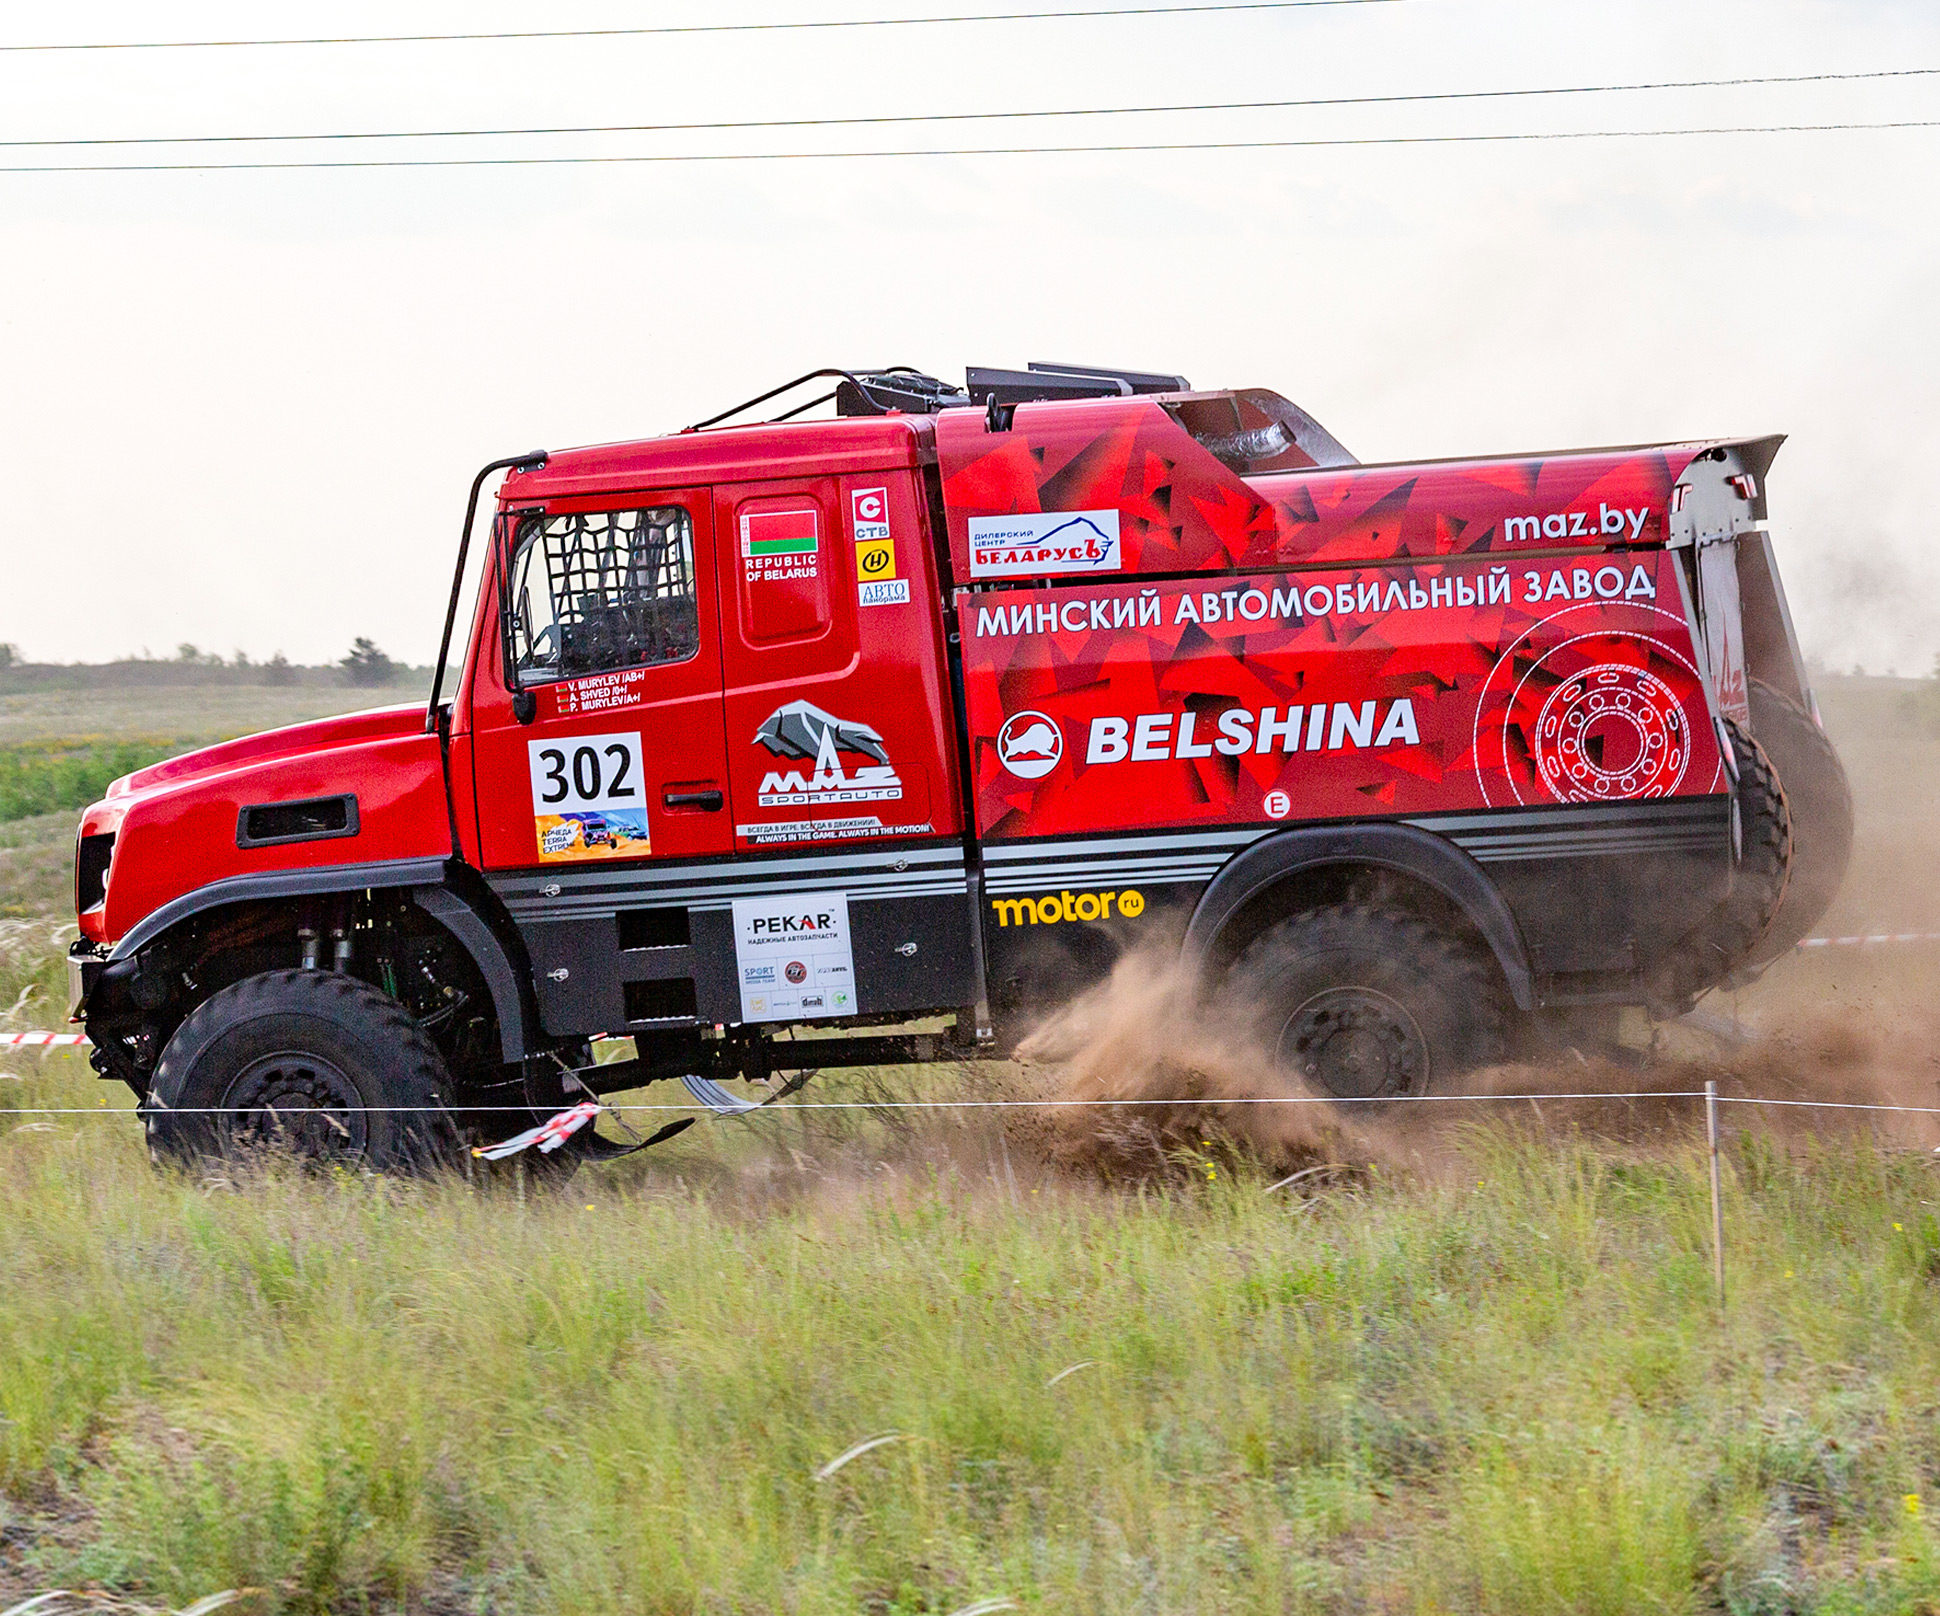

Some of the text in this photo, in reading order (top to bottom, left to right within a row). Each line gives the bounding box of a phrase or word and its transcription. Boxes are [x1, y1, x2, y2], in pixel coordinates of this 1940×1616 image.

[1504, 503, 1649, 541] maz.by
[856, 526, 888, 538] СТВ
[974, 530, 1034, 540] ДИЛЕРСКИЙ
[745, 554, 817, 570] REPUBLIC
[746, 567, 817, 582] OF BELARUS
[863, 582, 905, 599] АВТО
[976, 565, 1656, 637] МИНСКИЙ АВТОМОБИЛЬНЫЙ ЗАВОД
[568, 682, 577, 692] V.
[578, 675, 620, 690] MURYLEV
[569, 693, 579, 702] A.
[580, 687, 611, 701] SHVED
[570, 703, 578, 712] P.
[1086, 698, 1421, 765] BELSHINA
[539, 743, 635, 803] 302
[761, 789, 901, 804] SPORTAUTO
[1269, 796, 1284, 814] E
[801, 821, 826, 829] ВСЕГДА
[542, 836, 567, 846] TERRA
[756, 833, 787, 843] ALWAYS
[788, 832, 797, 841] IN
[798, 831, 811, 840] THE
[839, 829, 869, 838] ALWAYS
[870, 827, 879, 836] IN
[881, 826, 894, 835] THE
[992, 890, 1139, 927] motor ru
[753, 913, 831, 934] PEKAR
[747, 932, 838, 945] НАДЕЖНЫЕ АВТОЗАПЧАСТИ
[745, 966, 774, 976] SPORT
